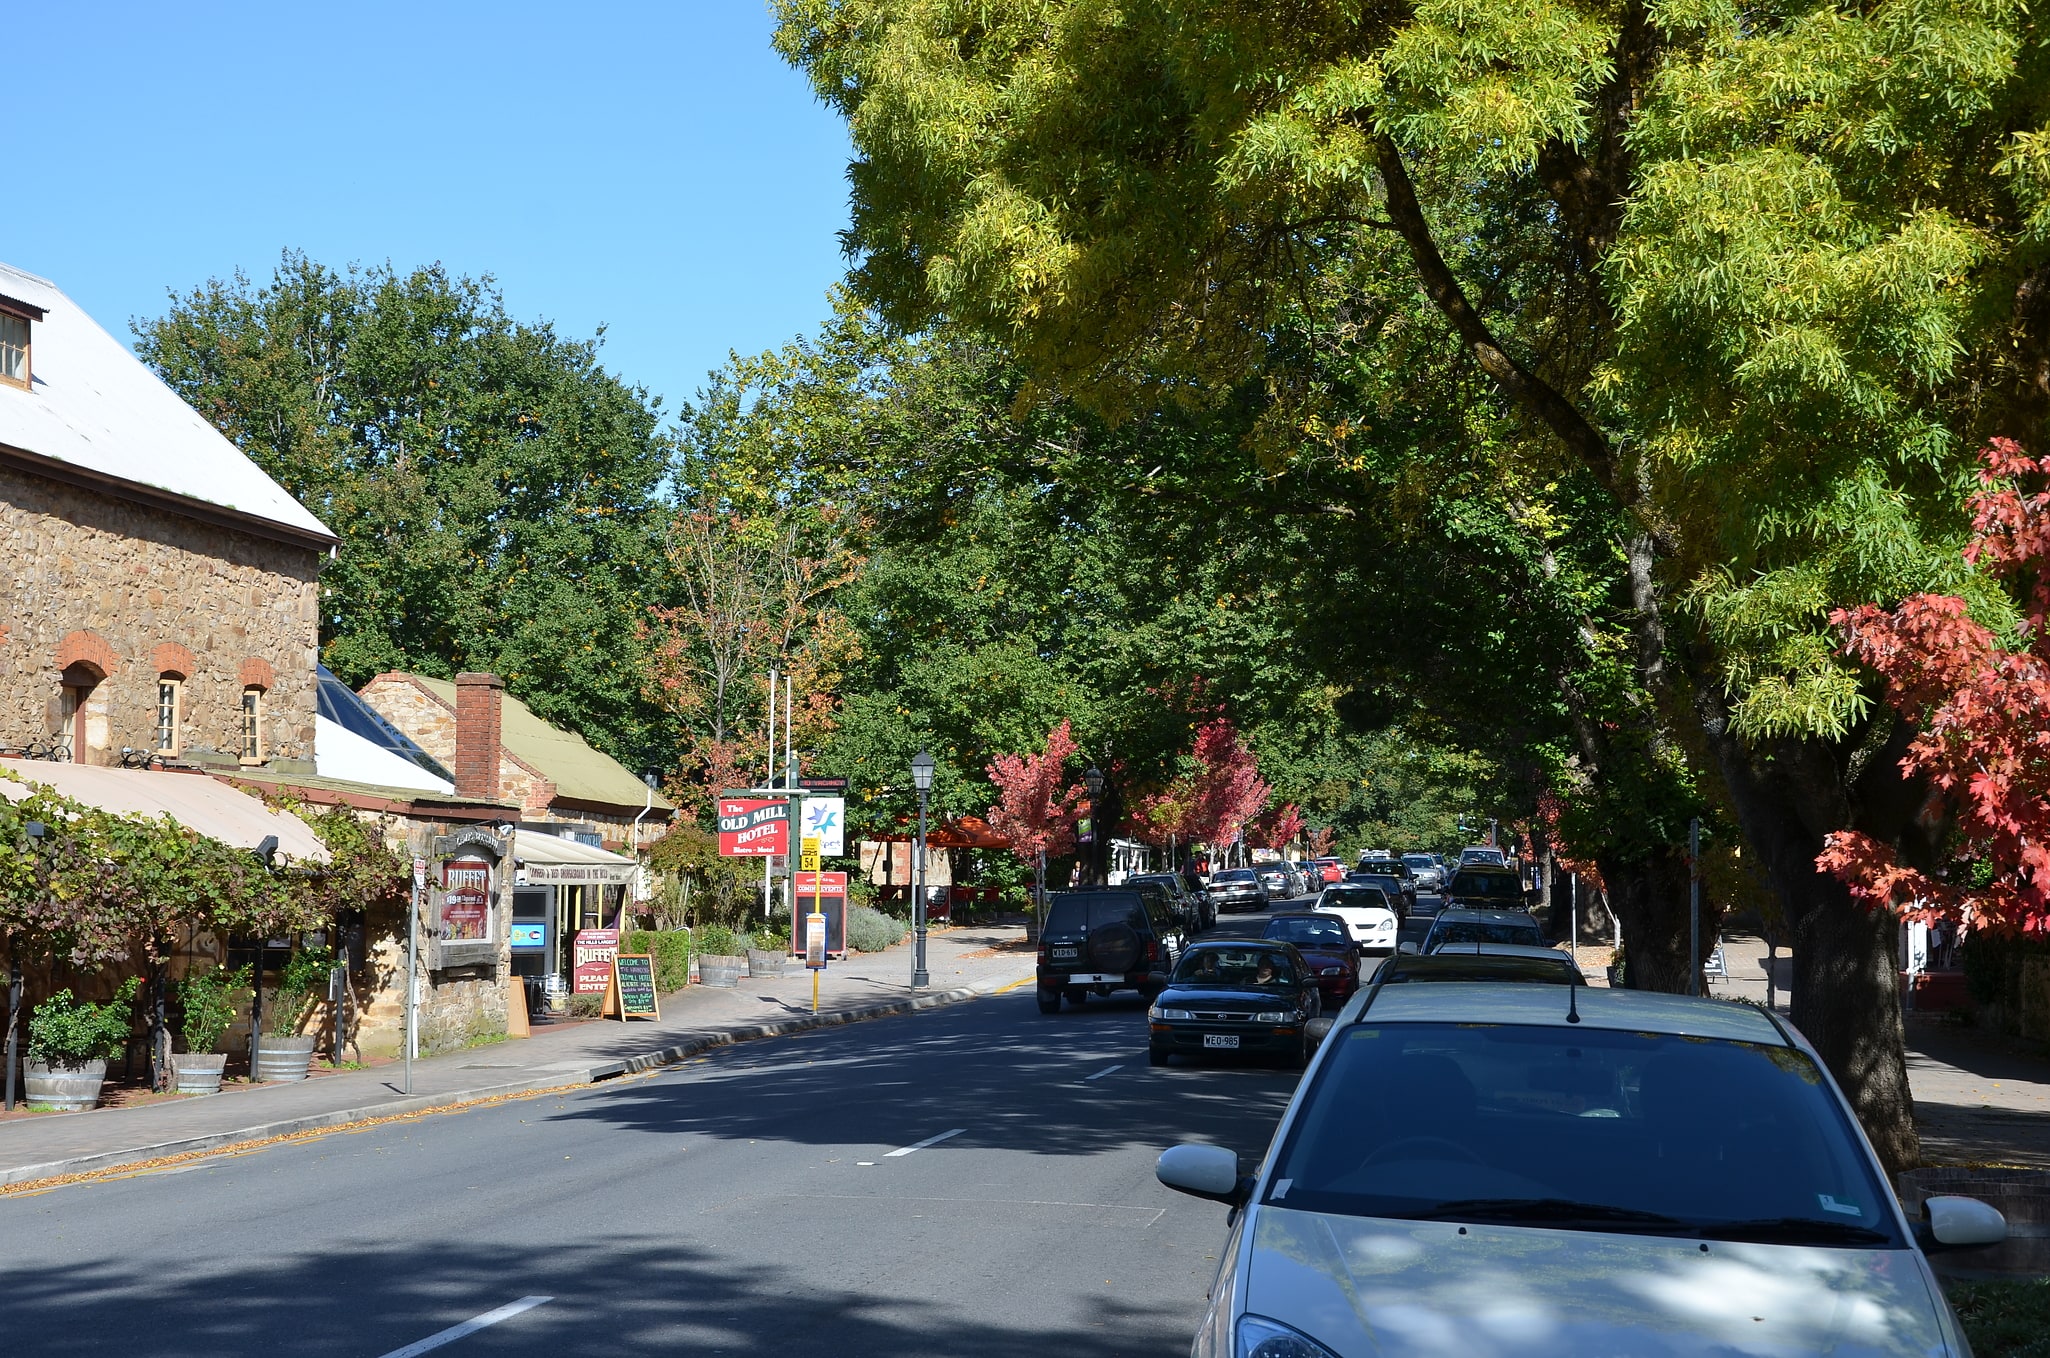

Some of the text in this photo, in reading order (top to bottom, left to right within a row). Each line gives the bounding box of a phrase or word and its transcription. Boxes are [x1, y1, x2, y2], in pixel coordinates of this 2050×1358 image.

[721, 806, 786, 830] OLD MILL
[726, 804, 744, 812] The
[738, 824, 778, 844] HOTEL
[804, 857, 813, 868] 54
[448, 869, 486, 895] BUFFET
[576, 947, 617, 967] BUFFET
[638, 974, 651, 982] HOTEL
